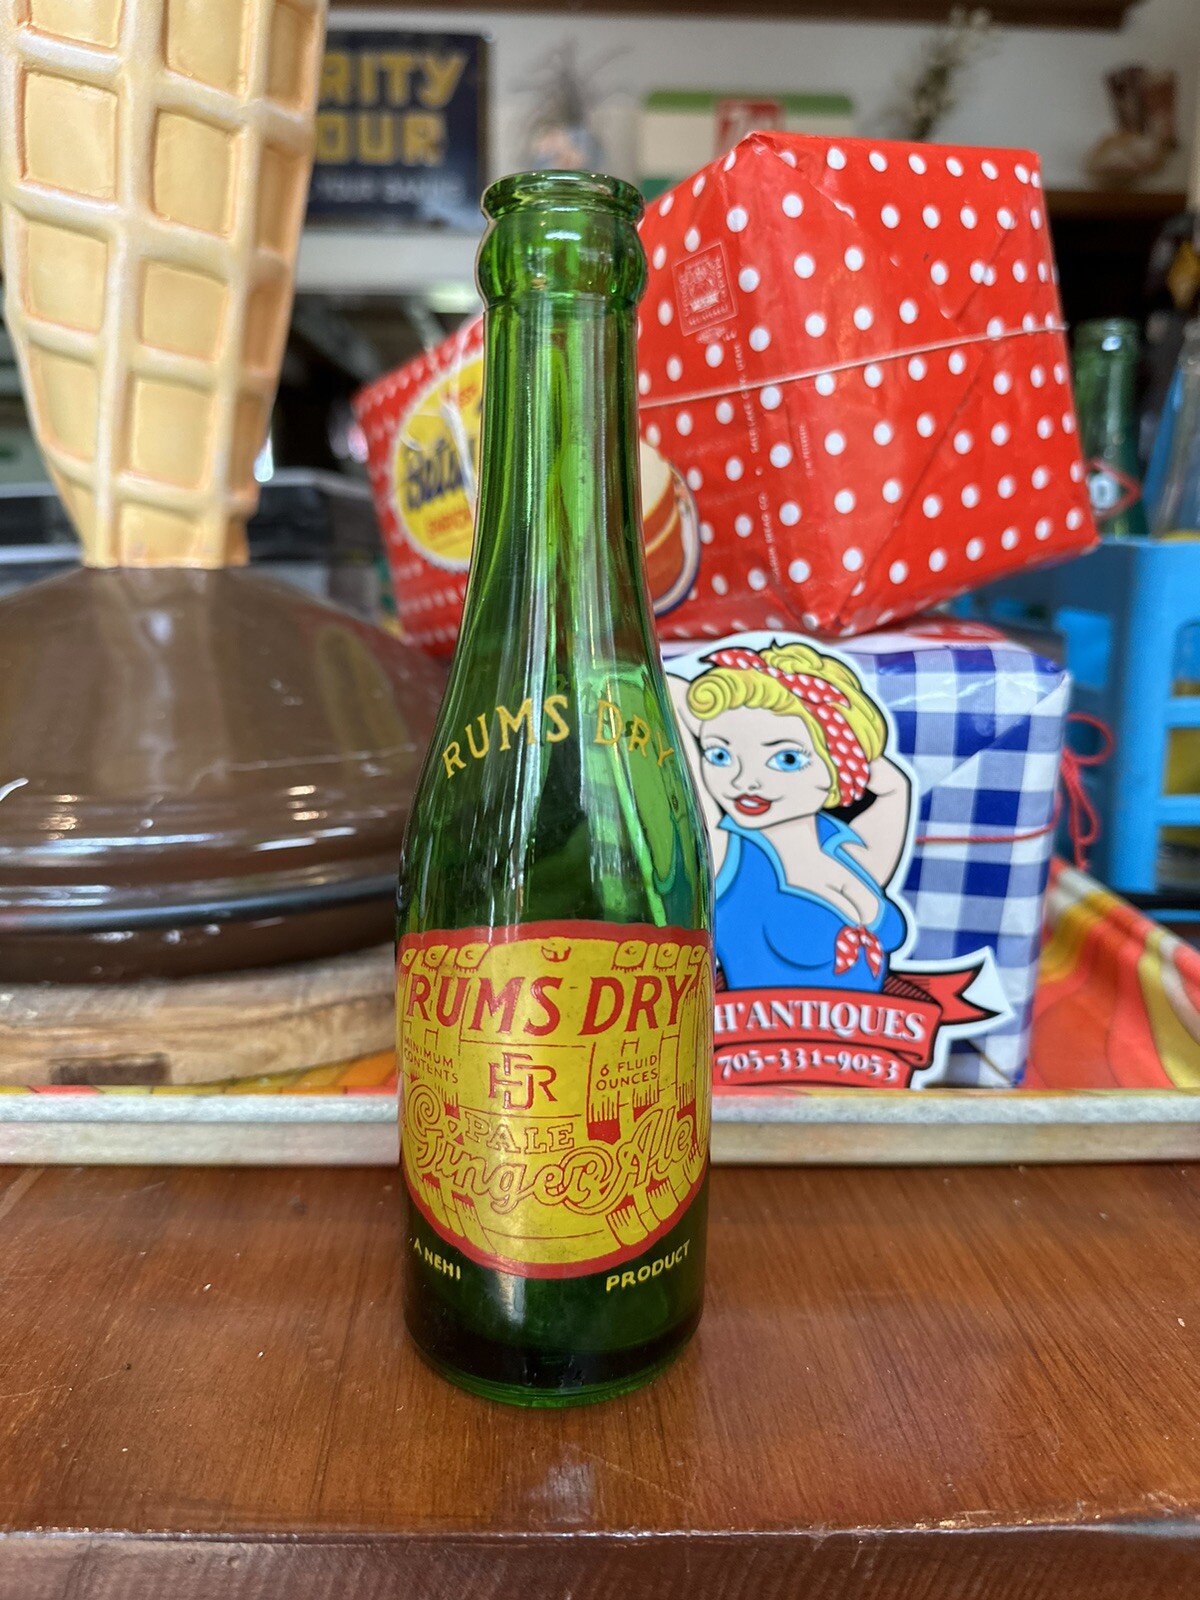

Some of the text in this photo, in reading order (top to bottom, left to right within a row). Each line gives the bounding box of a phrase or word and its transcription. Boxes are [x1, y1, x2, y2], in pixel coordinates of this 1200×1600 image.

[442, 695, 675, 779] RUMS DRY
[407, 973, 691, 1036] RUMS DRY
[404, 1036, 454, 1069] MINIMUM
[404, 1047, 459, 1084] CONTENTS
[600, 1054, 657, 1077] 6 FLUID
[717, 1047, 900, 1083] 705-331-9053
[596, 1067, 658, 1091] OUNCES
[407, 1084, 695, 1216] Ginger Ale
[464, 1111, 575, 1155] PALE
[414, 1237, 690, 1292] A NEHI PRODUCT
